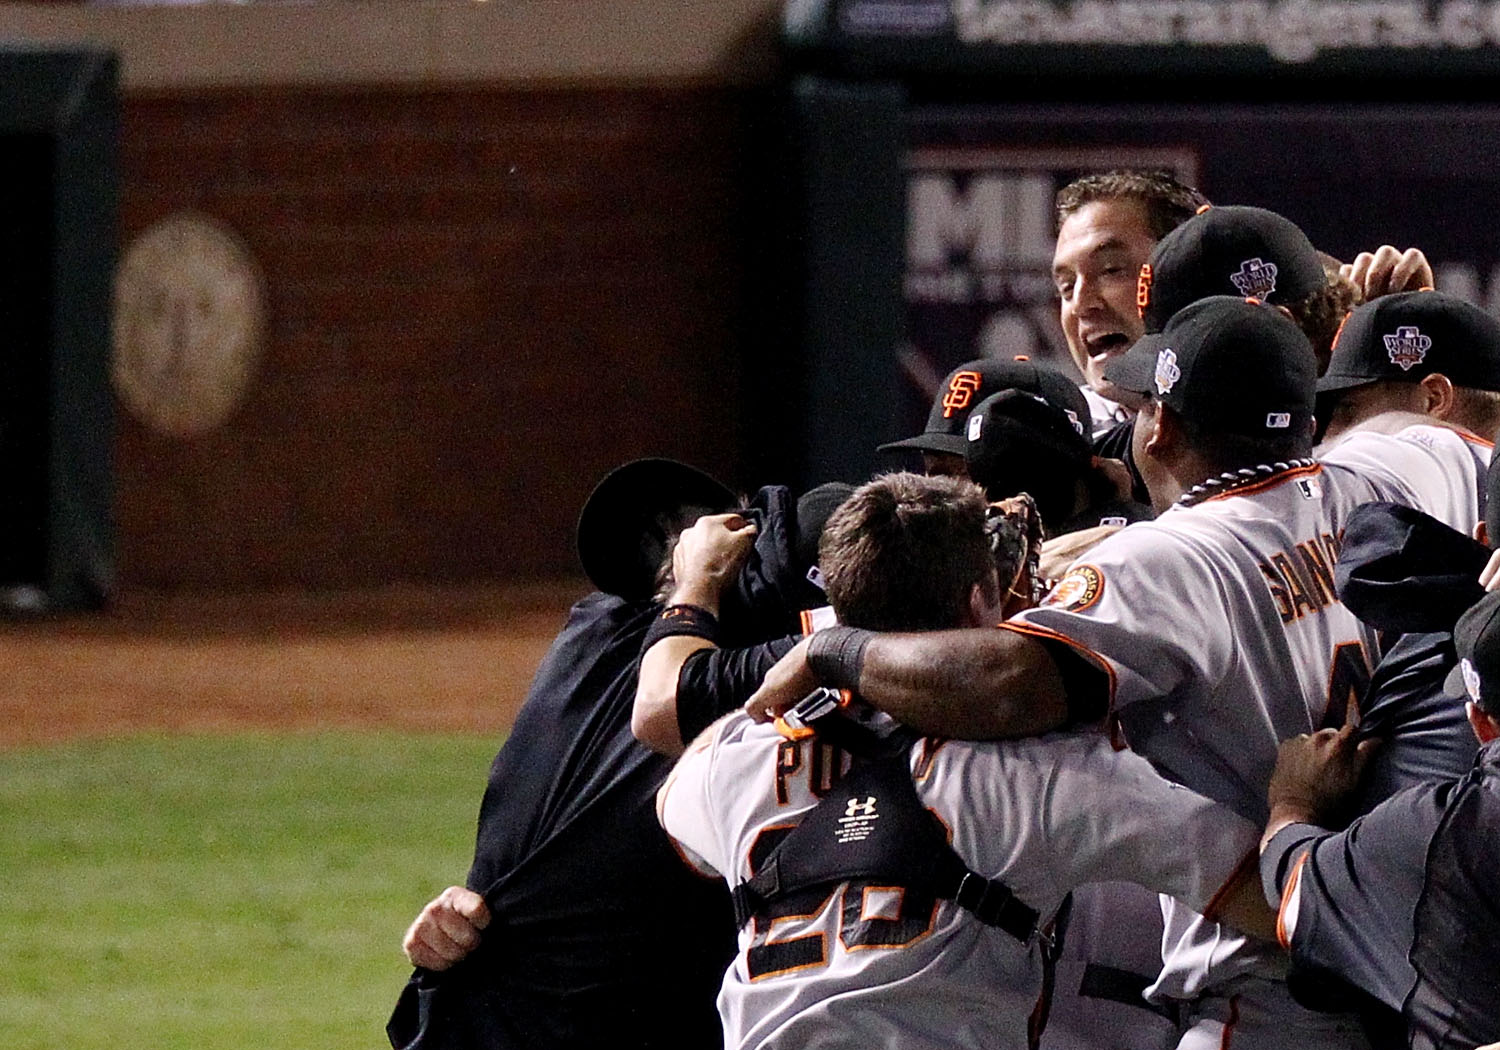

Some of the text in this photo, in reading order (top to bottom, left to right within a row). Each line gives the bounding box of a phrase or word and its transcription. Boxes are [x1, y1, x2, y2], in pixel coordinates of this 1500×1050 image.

[903, 172, 1056, 266] ML
[1385, 336, 1431, 350] WORLD
[943, 370, 983, 419] SF
